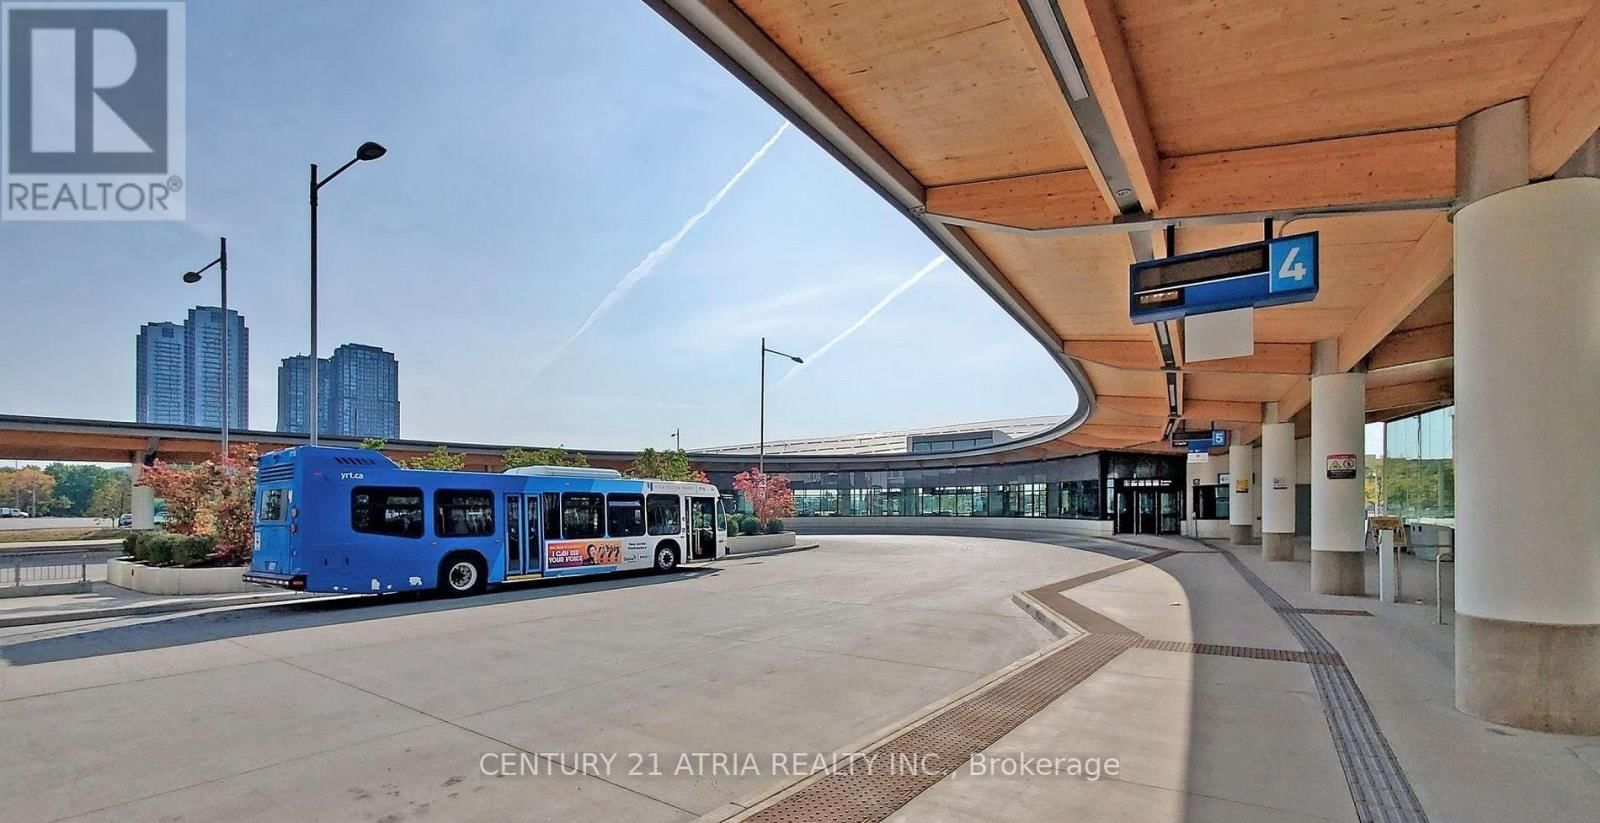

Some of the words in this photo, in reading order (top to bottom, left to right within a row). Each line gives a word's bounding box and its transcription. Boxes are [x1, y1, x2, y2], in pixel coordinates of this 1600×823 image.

[1278, 247, 1307, 281] 4
[1215, 432, 1224, 443] 5
[340, 471, 364, 480] yrt.ca
[548, 556, 565, 564] YOUR
